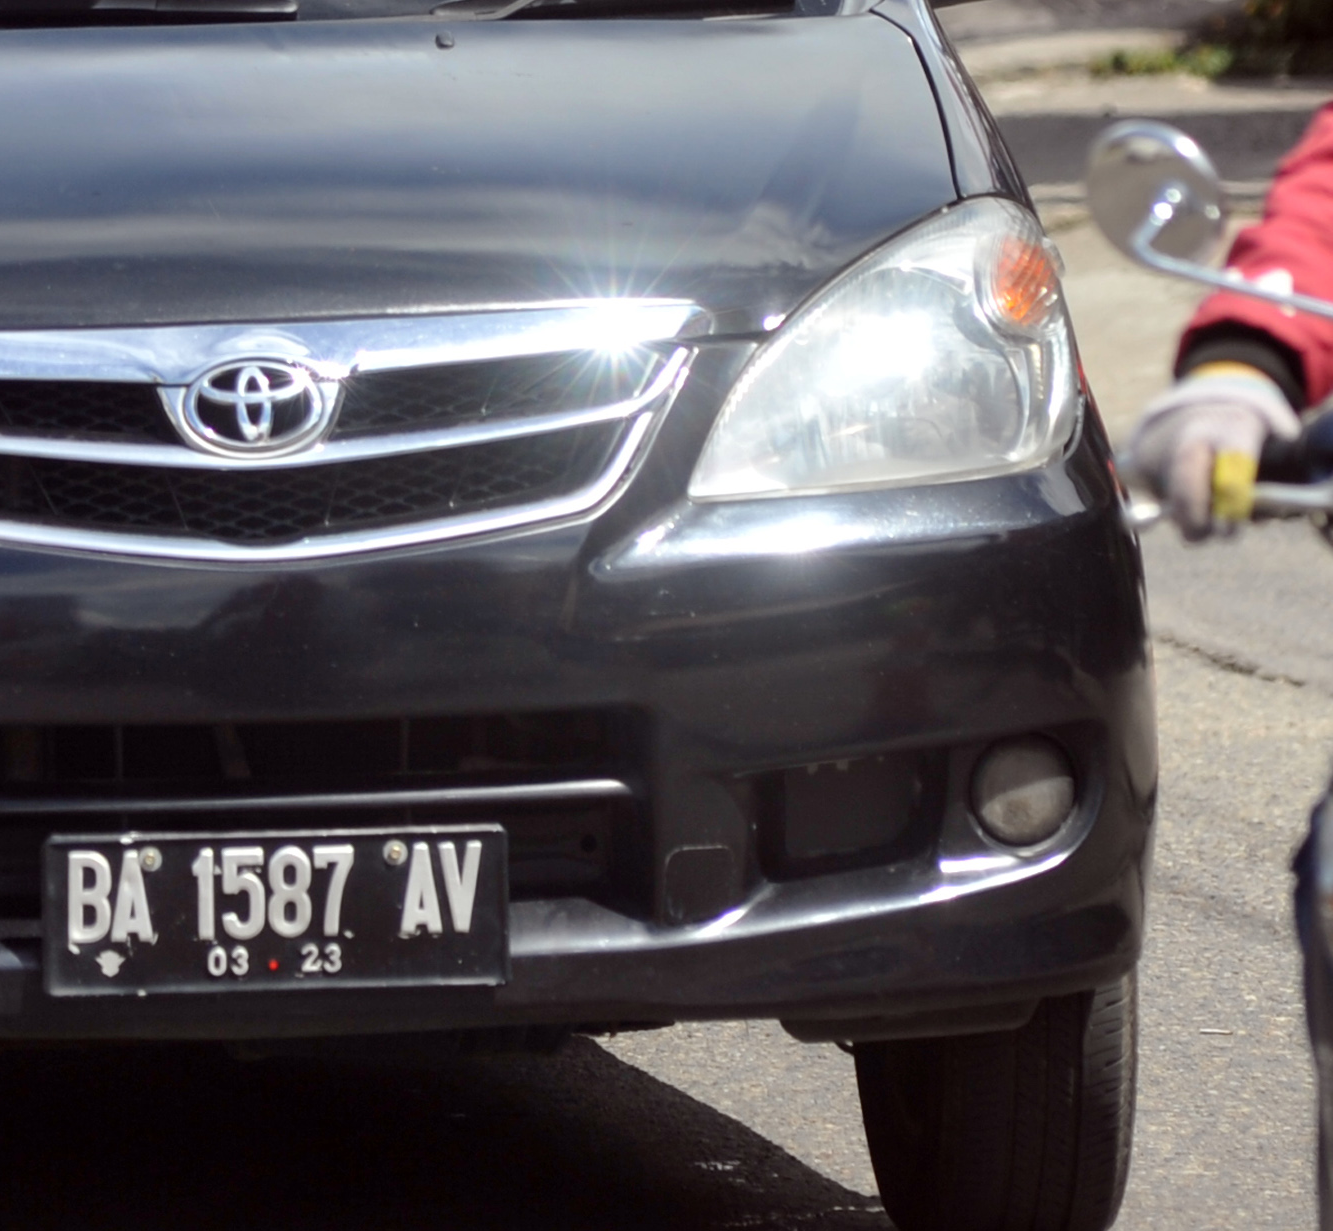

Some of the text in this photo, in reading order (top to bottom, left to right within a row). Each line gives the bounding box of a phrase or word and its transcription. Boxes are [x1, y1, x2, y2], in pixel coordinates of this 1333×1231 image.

[68, 840, 482, 945] BA 1587 AV
[206, 941, 343, 977] 03 23
